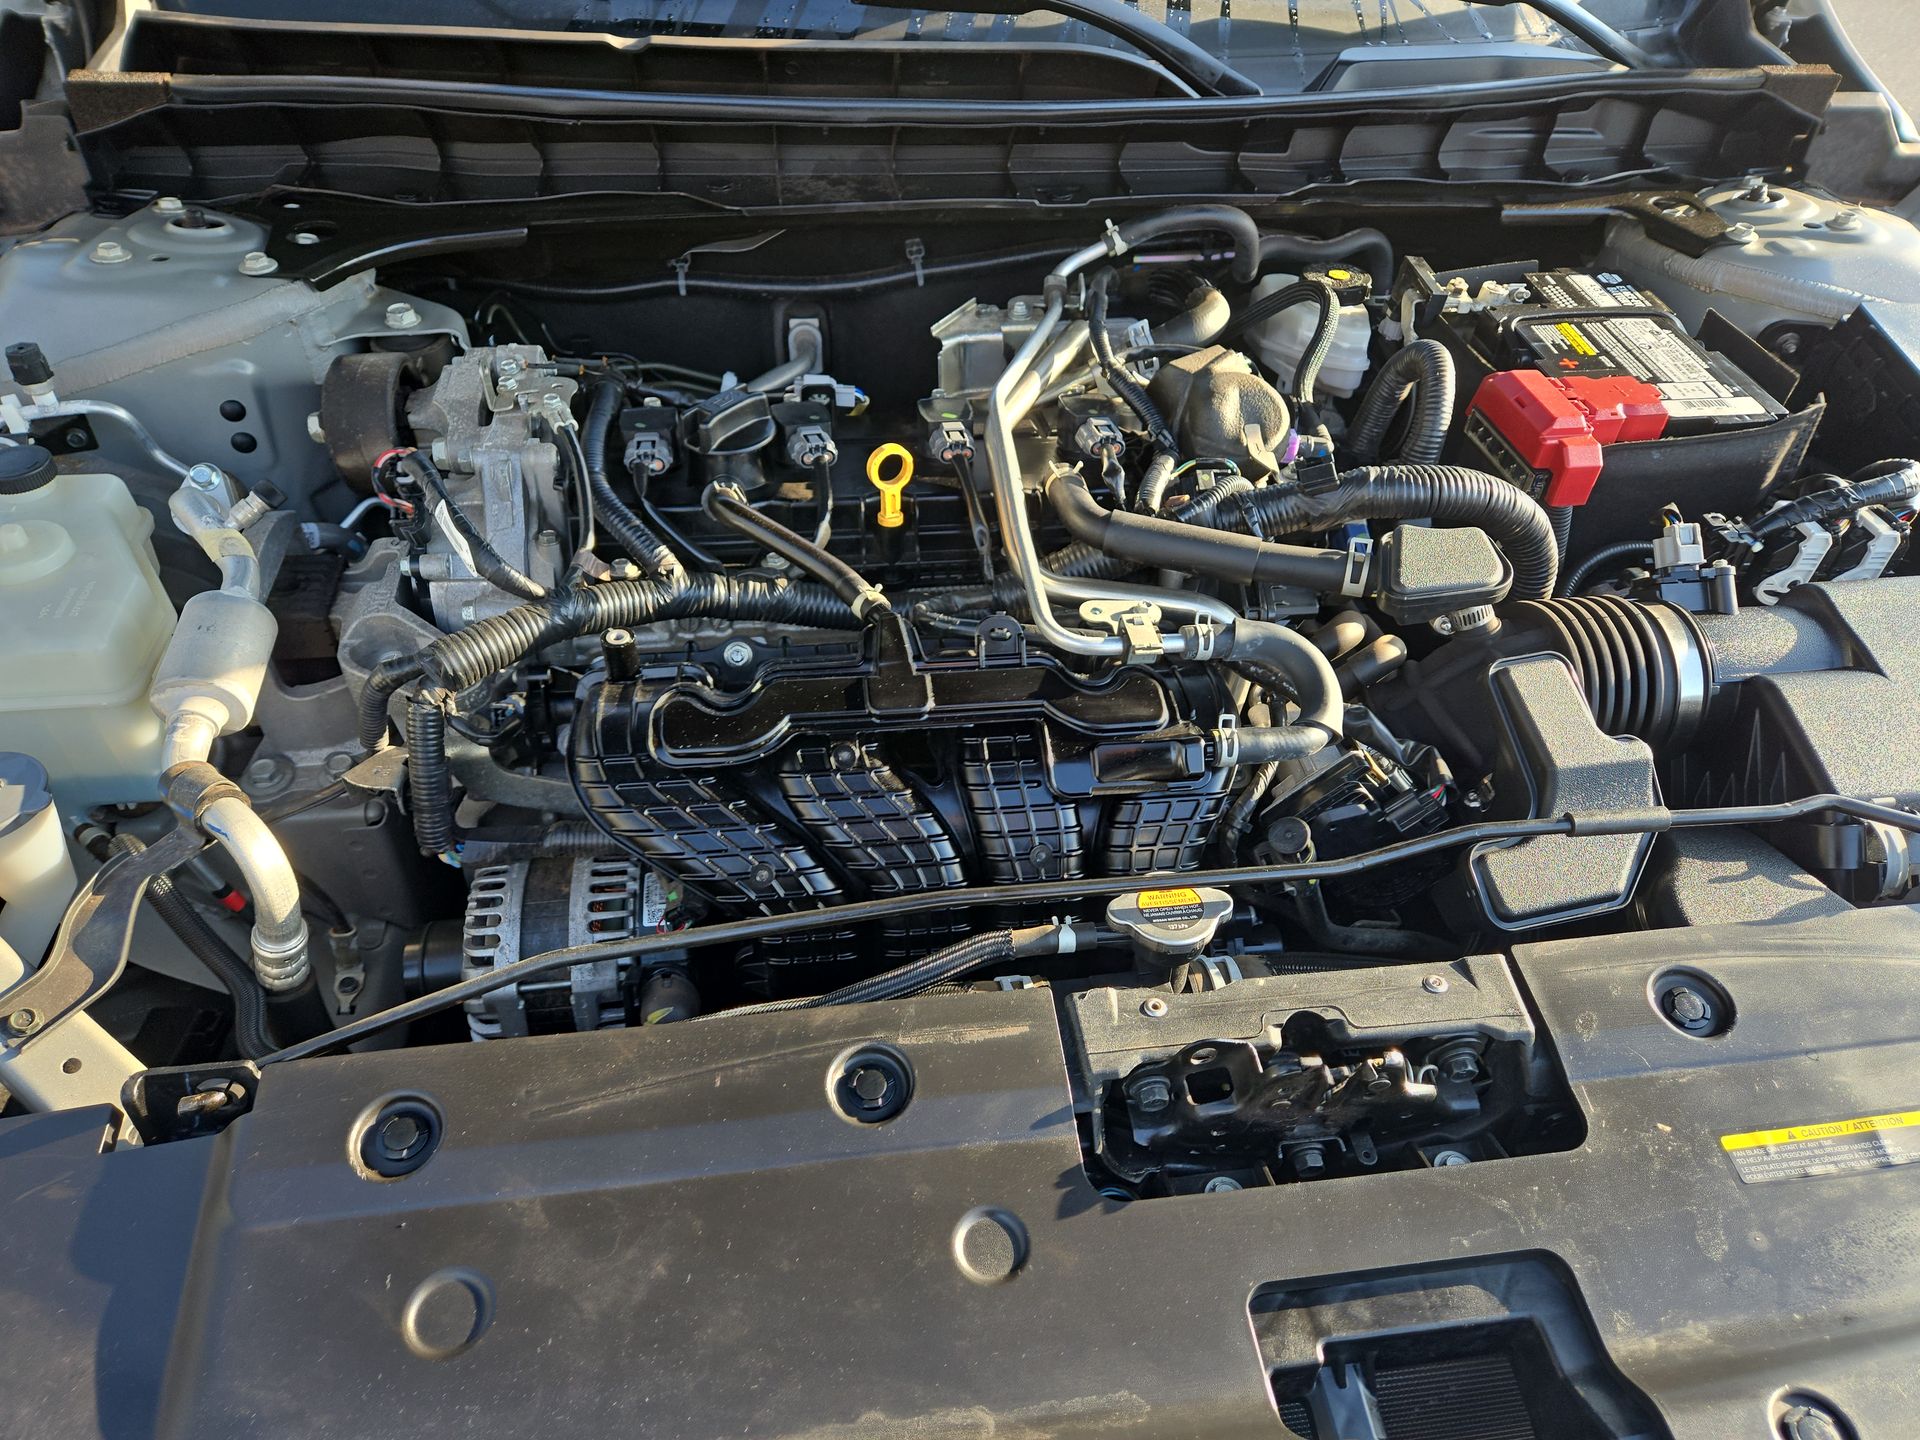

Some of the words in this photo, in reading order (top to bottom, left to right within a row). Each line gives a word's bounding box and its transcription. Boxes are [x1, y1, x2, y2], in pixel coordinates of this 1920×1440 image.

[1147, 891, 1187, 901] WARNING
[1141, 896, 1198, 907] AVERTISSEMENT
[1801, 1125, 1842, 1137] CAUTION
[1745, 1147, 1767, 1155] BLADE
[1781, 1150, 1814, 1159] PERSONAL
[1848, 1141, 1872, 1150] HANDS
[1785, 1166, 1807, 1175] TOUTE
